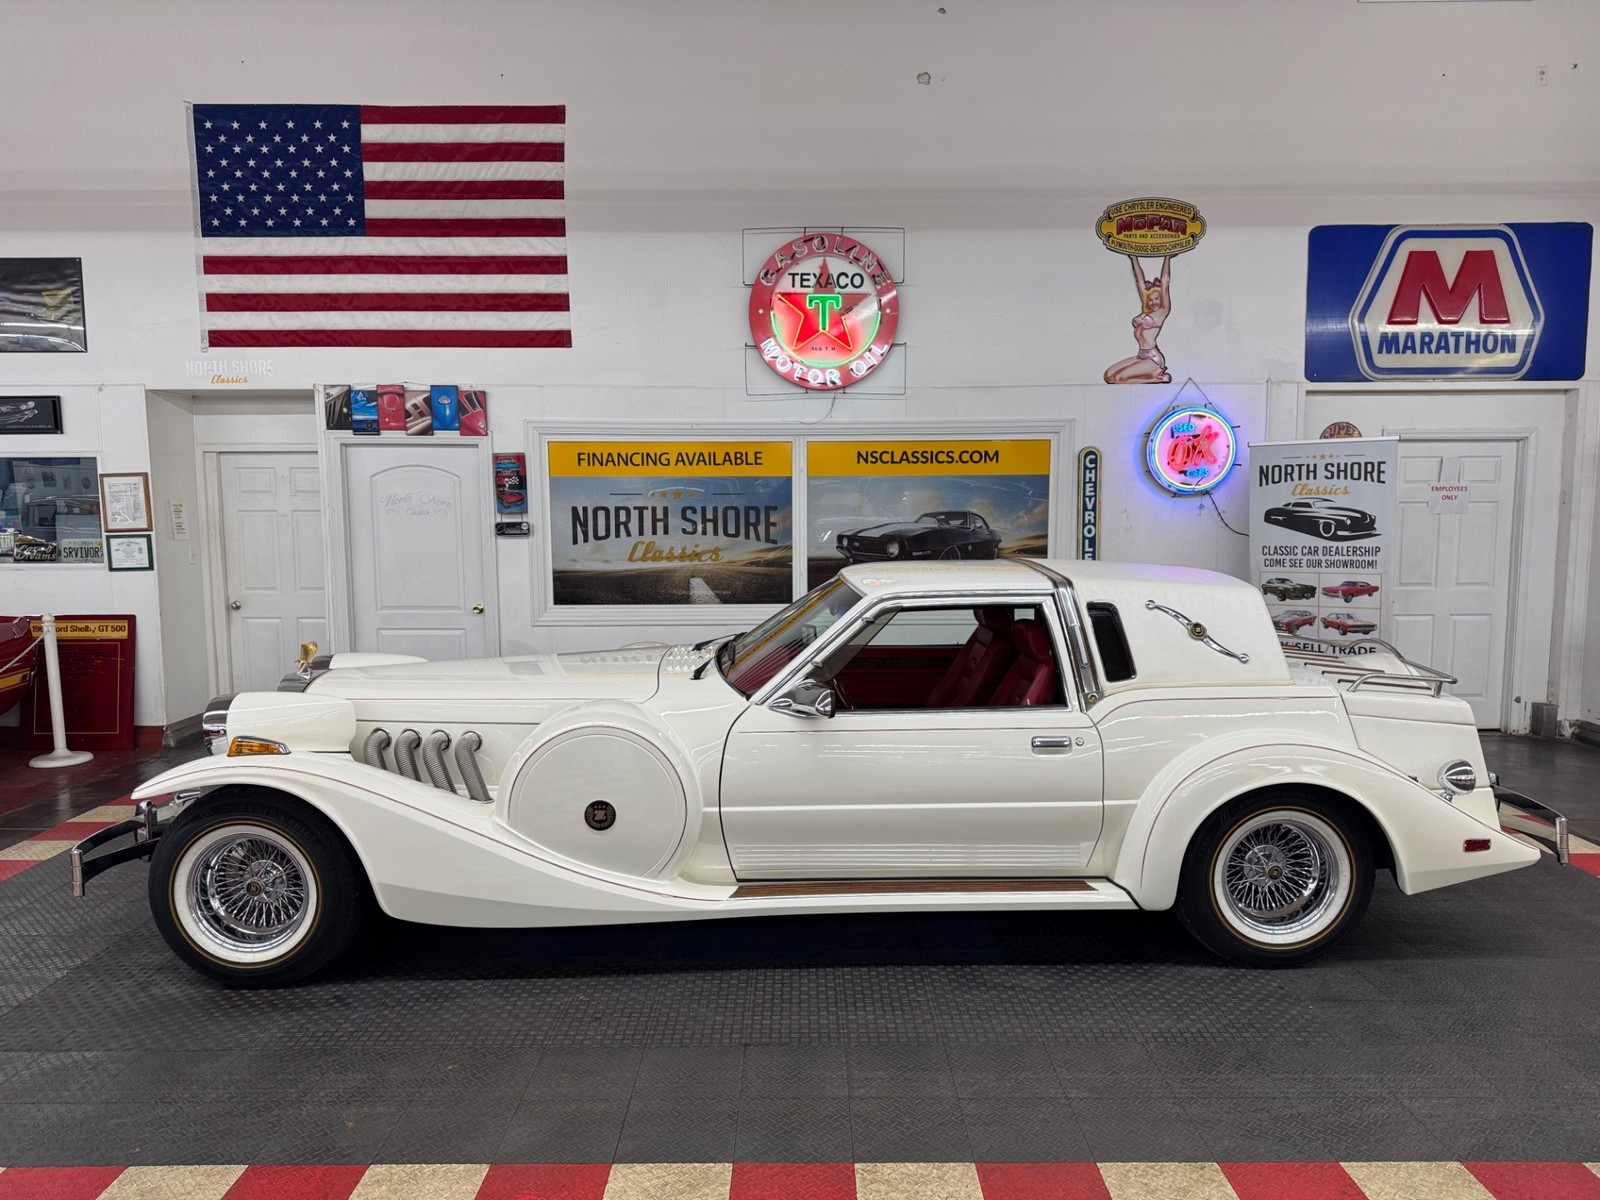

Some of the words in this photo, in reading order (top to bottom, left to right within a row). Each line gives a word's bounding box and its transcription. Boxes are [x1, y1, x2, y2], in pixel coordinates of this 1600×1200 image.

[1110, 205, 1122, 215] USE
[1124, 201, 1155, 211] CHRYSLER
[1155, 201, 1192, 215] ENGINEERED
[1116, 214, 1188, 235] MOPAR
[759, 234, 892, 289] GASOLINE
[788, 272, 865, 289] TEXACO
[1386, 250, 1511, 325] M
[806, 294, 842, 332] T
[1377, 331, 1517, 354] MARATHON
[185, 360, 227, 377] NORTH
[232, 359, 274, 376] SHORE
[760, 337, 842, 387] MOTOR
[850, 343, 888, 377] OIL
[211, 374, 248, 384] Classics
[1173, 424, 1195, 432] USED
[577, 452, 671, 467] FINANCING
[675, 451, 763, 466] AVAILABLE
[857, 450, 999, 464] NSCLASSICS.COM
[1259, 463, 1317, 487] NORTH
[1324, 461, 1386, 484] SHORE
[1291, 483, 1351, 496] Classics
[571, 506, 669, 545] NORTH
[681, 506, 778, 545] SHORE
[63, 547, 100, 558] SRVIVOR
[627, 540, 724, 563] Classics
[1262, 545, 1298, 556] CLASSIC
[1301, 546, 1319, 556] CAR
[1322, 546, 1381, 557] DEALERSHIP
[1264, 558, 1287, 568] COME
[1289, 559, 1303, 568] SEE
[1306, 559, 1322, 568] OUR
[1324, 559, 1378, 569] SHOWROOM!
